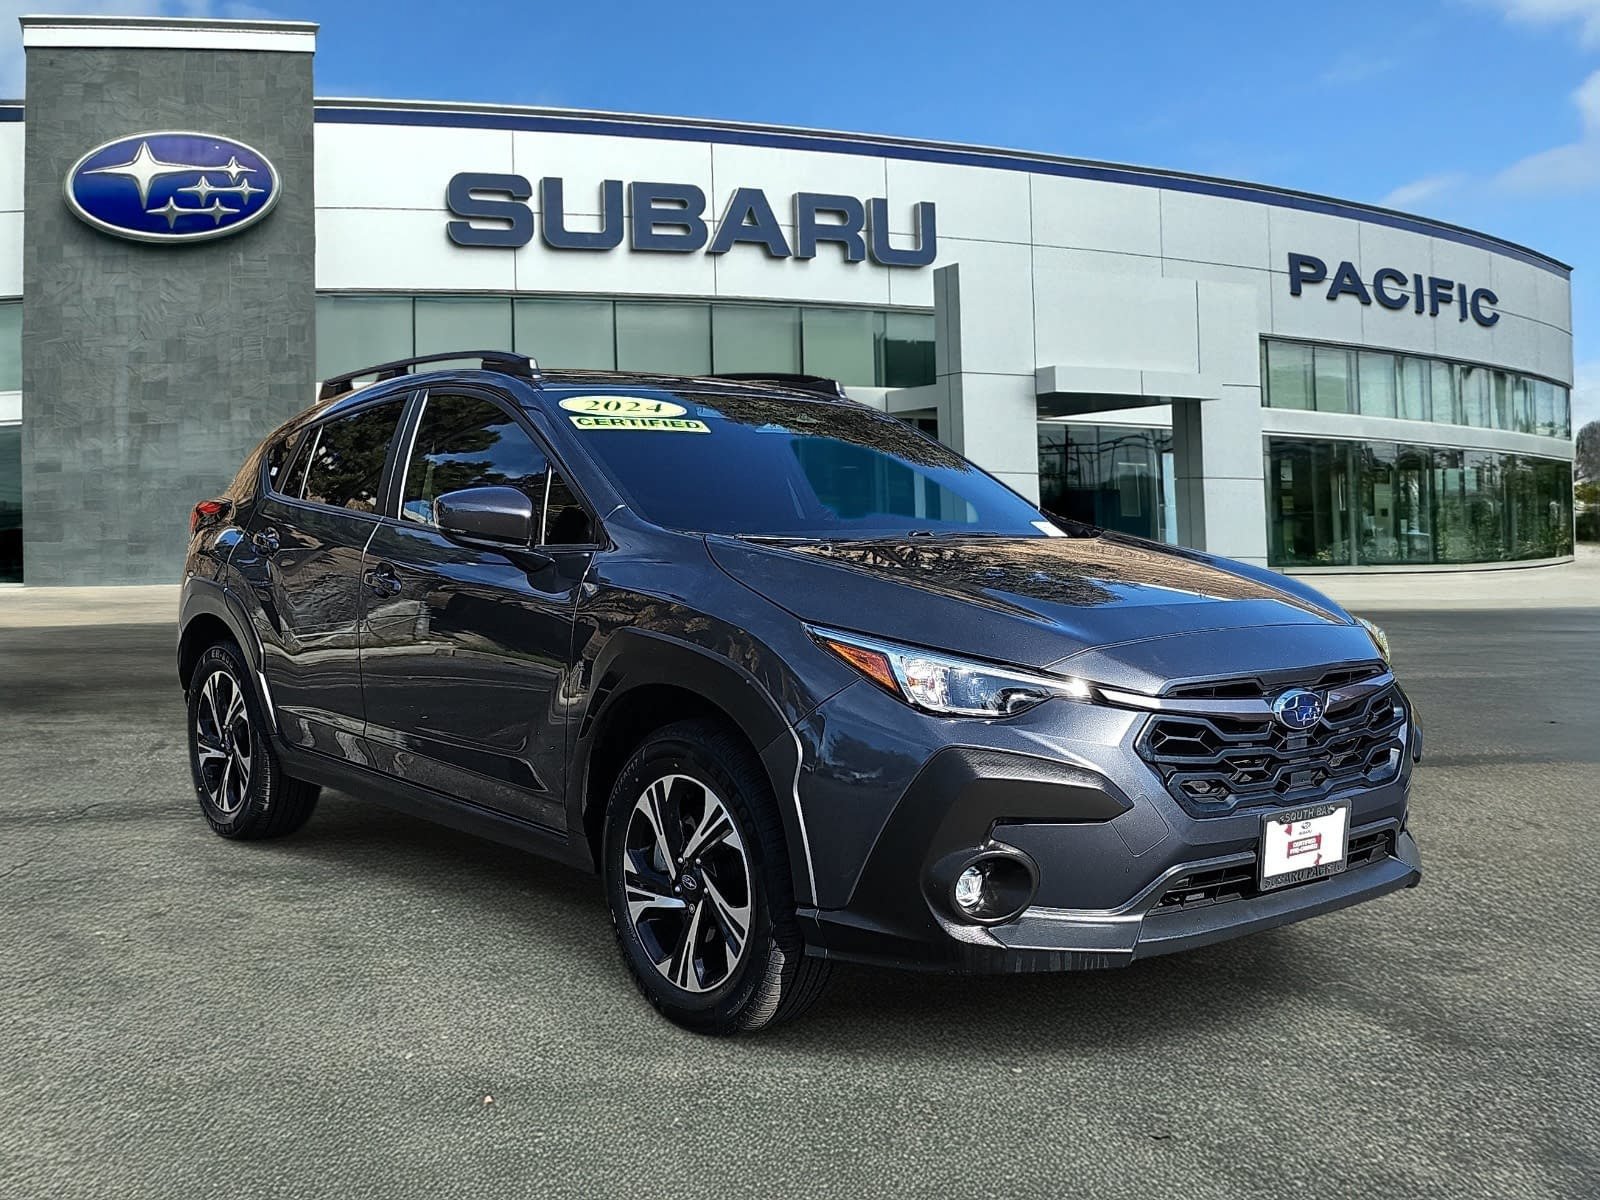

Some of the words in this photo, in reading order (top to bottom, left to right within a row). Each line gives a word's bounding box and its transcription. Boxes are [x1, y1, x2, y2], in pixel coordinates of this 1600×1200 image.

[447, 172, 937, 267] SUBARU
[1288, 252, 1500, 327] PACIFIC
[584, 400, 662, 412] 2024
[576, 418, 700, 429] CERTIFIED
[1285, 808, 1314, 822] SOUTH
[1317, 805, 1334, 816] BAY
